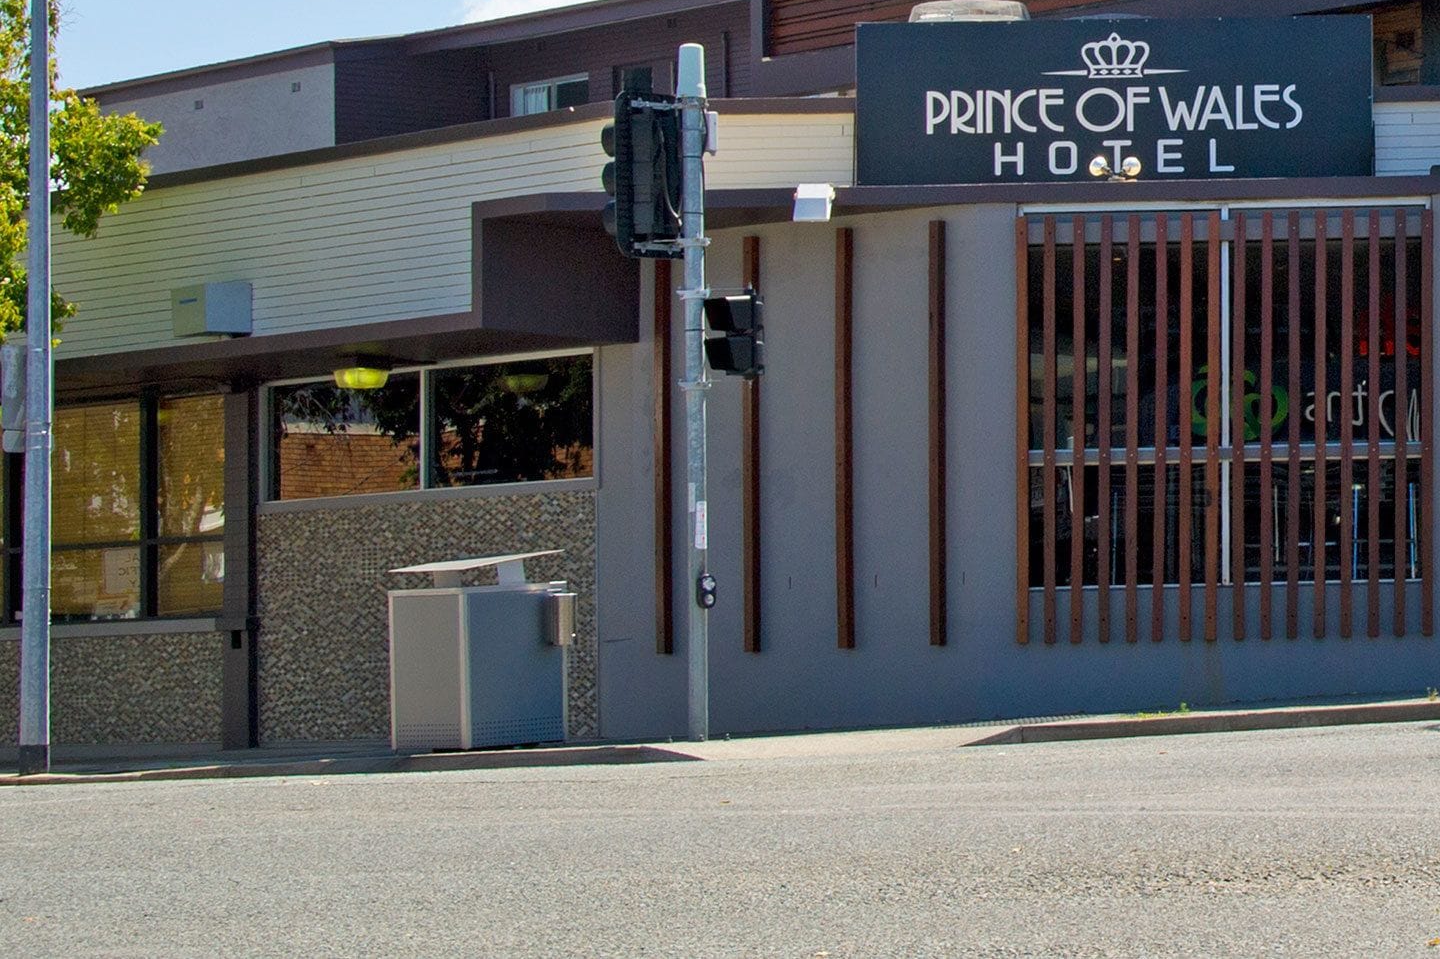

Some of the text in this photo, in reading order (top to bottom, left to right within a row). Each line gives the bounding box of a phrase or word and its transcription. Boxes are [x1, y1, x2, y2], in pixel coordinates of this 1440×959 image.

[926, 83, 1303, 135] PRINCE OF WALES
[994, 138, 1236, 176] HOTEL
